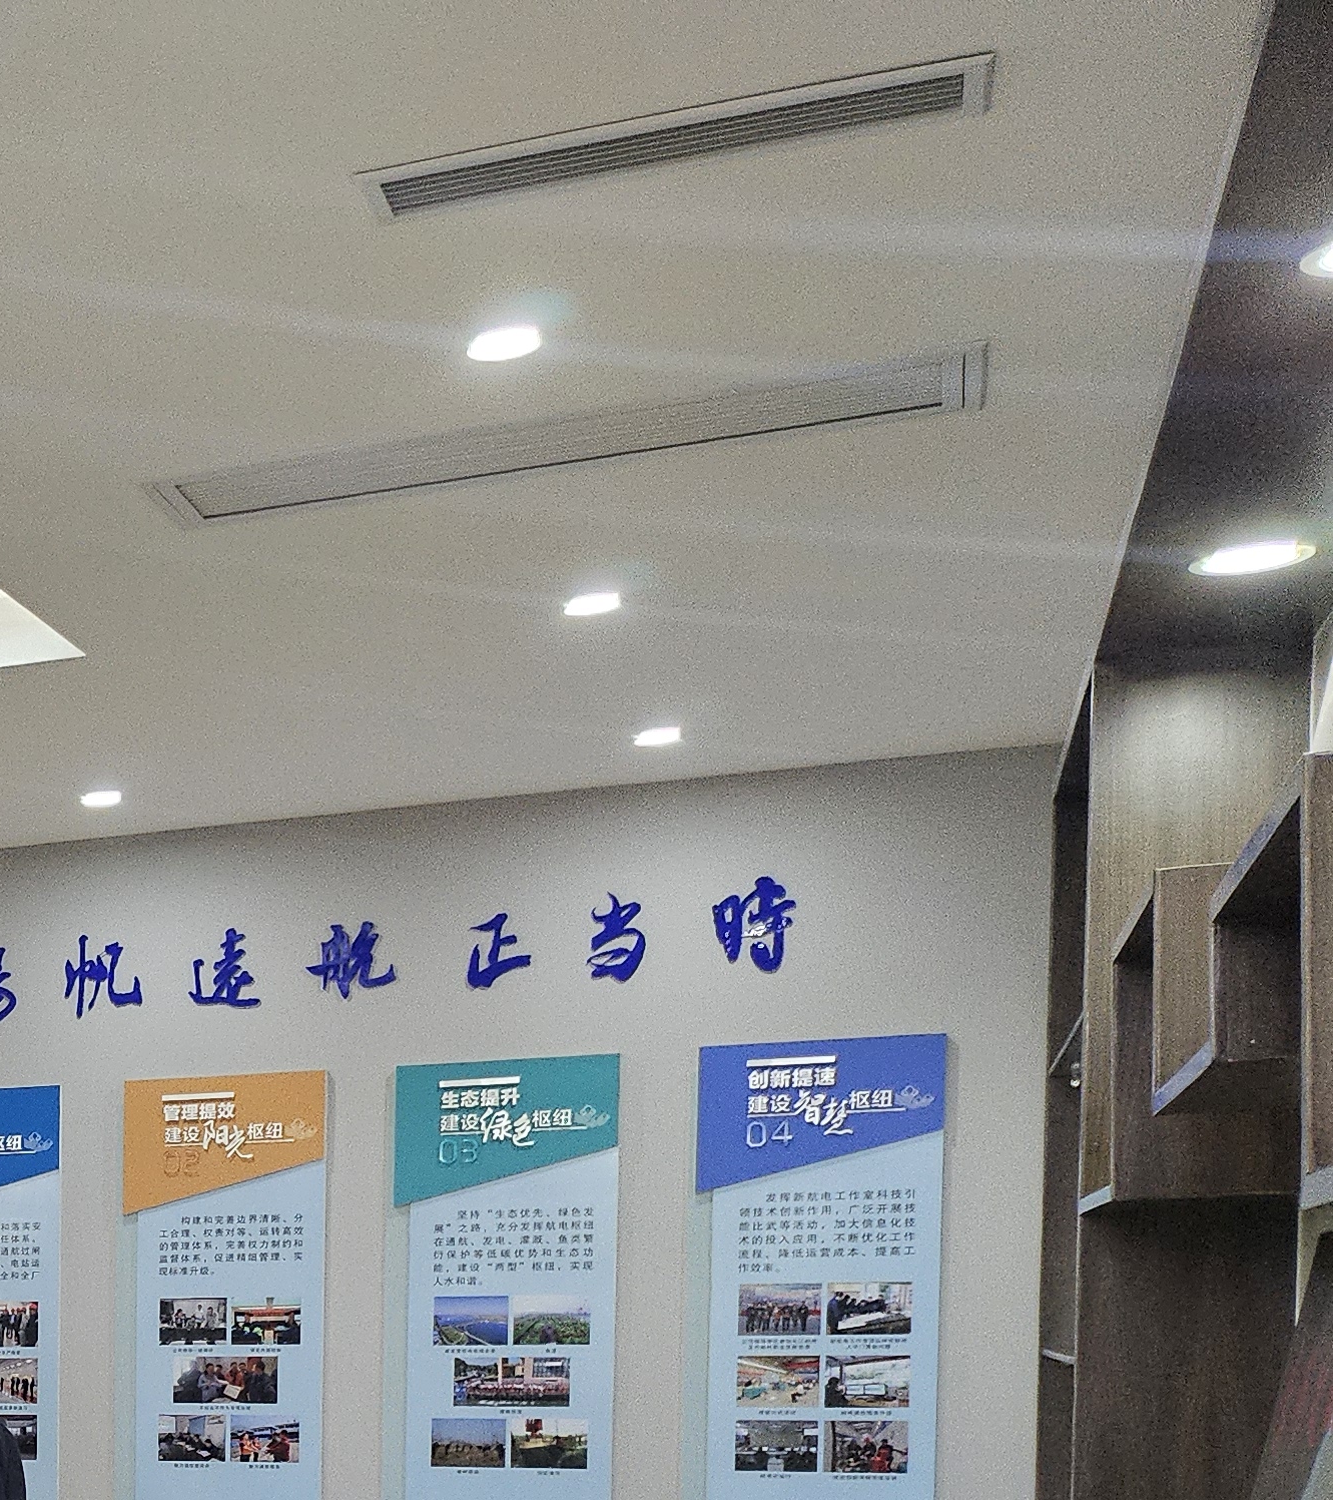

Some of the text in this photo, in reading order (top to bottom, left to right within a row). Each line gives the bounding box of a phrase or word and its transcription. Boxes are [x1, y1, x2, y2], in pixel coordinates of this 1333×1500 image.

[748, 1067, 837, 1089] 创新提速
[163, 1102, 236, 1122] 管理提效
[440, 1088, 520, 1109] 生态提升
[748, 1089, 893, 1135] 建设智慧枢纽
[165, 1120, 283, 1159] 建设阳光枢纽
[440, 1108, 573, 1146] 建设绿色枢纽
[746, 1119, 793, 1148] 04
[163, 1149, 200, 1177] 02
[439, 1138, 478, 1164] 03
